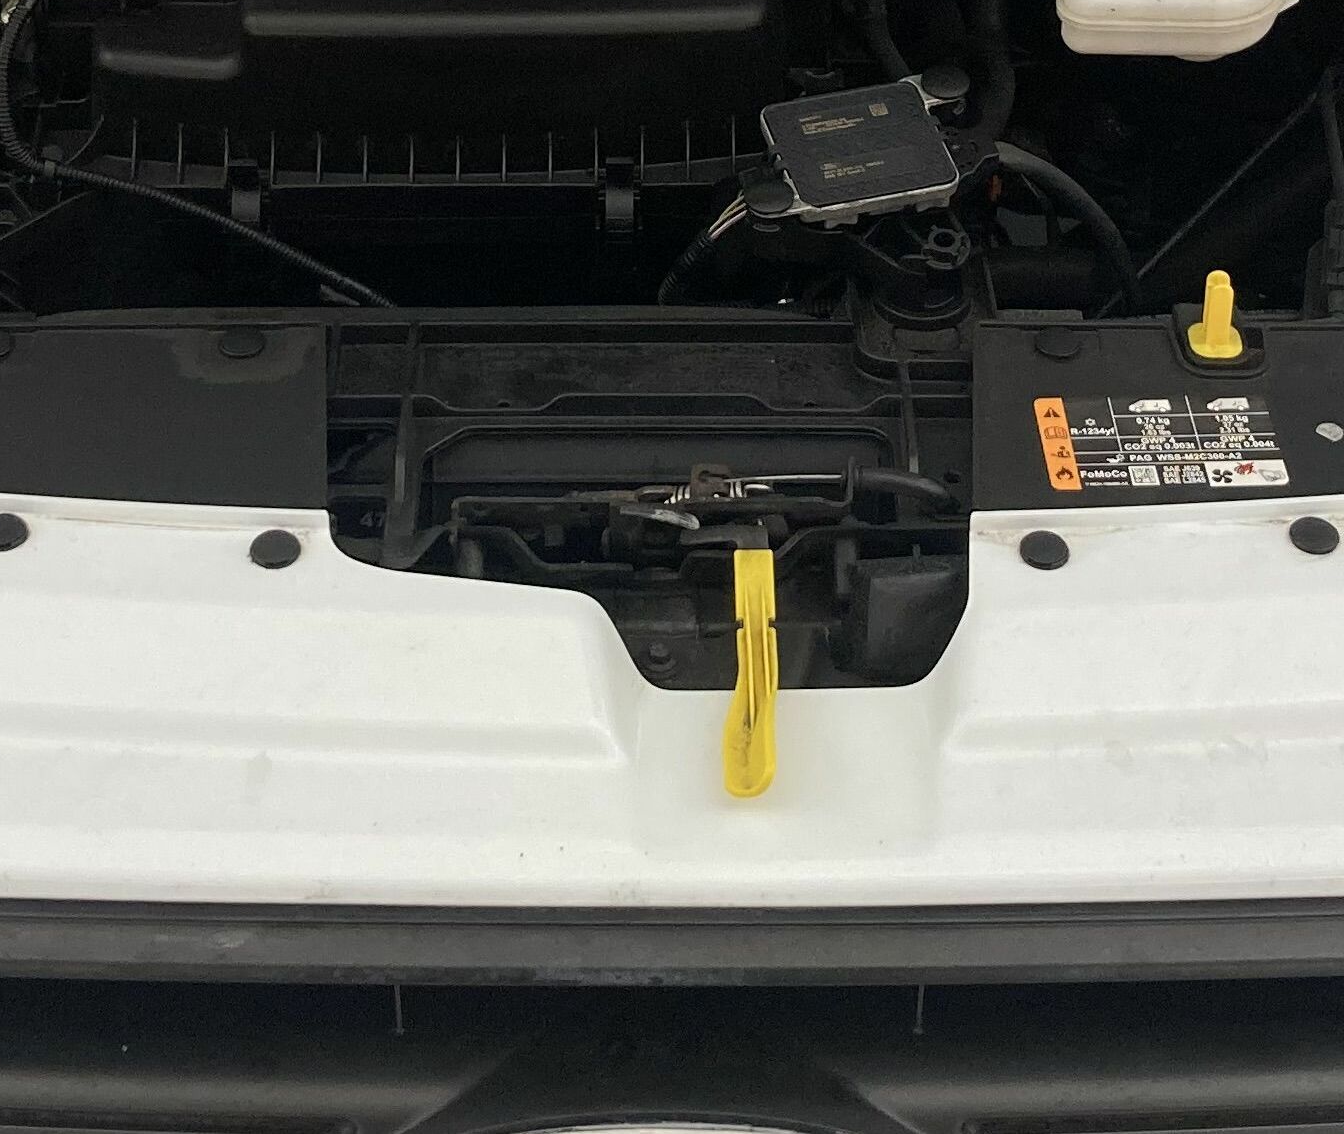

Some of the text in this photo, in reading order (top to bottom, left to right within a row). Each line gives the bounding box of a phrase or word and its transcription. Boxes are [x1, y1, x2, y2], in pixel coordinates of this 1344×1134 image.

[1136, 416, 1171, 426] 0.74 kg
[1215, 414, 1249, 423] 1.05 kg
[1070, 427, 1115, 436] R-1234yf
[1124, 443, 1148, 451] CO2
[1164, 442, 1196, 450] 0.003t
[1203, 441, 1227, 449] CO2
[1243, 440, 1276, 448] 0.004t
[1129, 454, 1153, 462] PAG
[1079, 469, 1128, 479] FoMoCo
